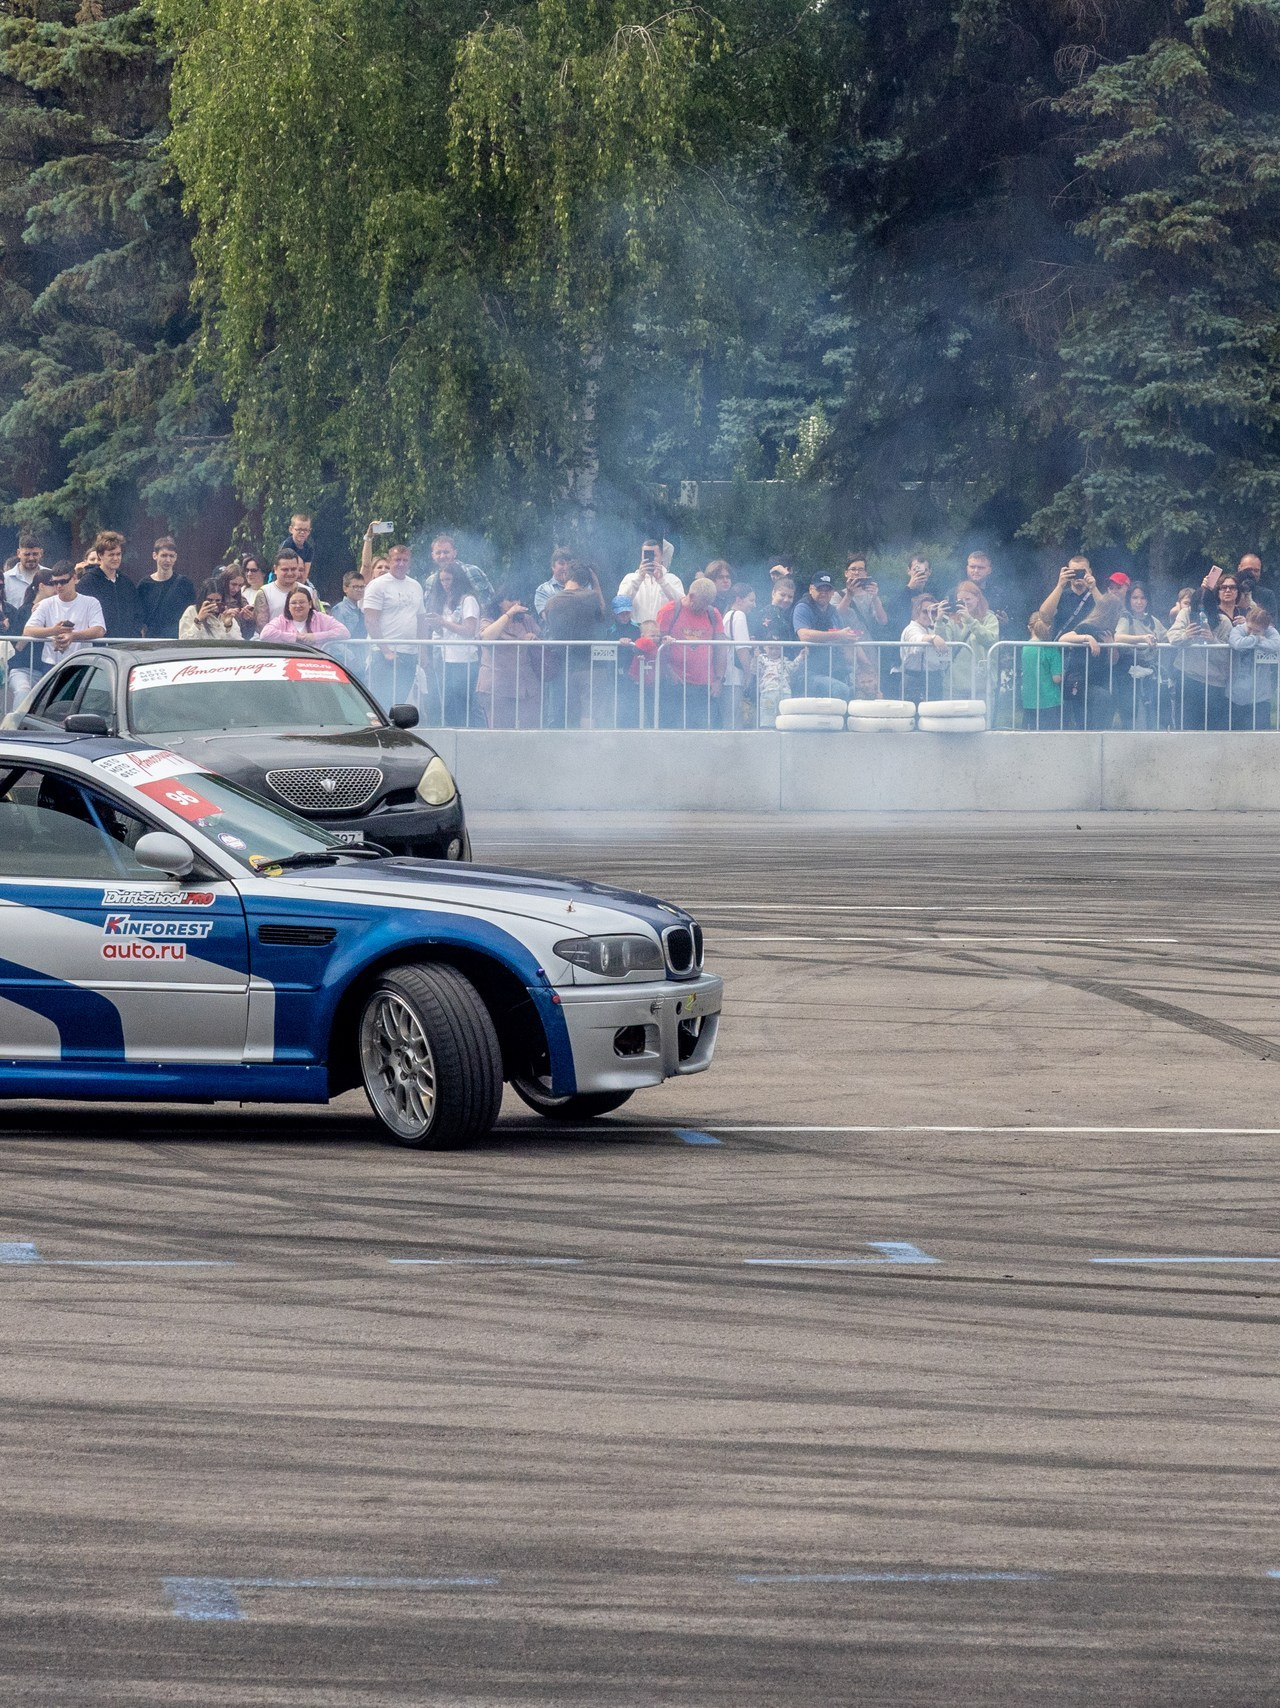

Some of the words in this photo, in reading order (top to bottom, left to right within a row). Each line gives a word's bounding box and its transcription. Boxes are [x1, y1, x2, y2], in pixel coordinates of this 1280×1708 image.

[172, 662, 277, 682] Автострада
[100, 758, 120, 769] АВТО
[110, 763, 130, 773] МОТО
[120, 767, 140, 778] ФЕСТ
[165, 790, 200, 806] 96
[104, 916, 210, 936] KINFOREST
[102, 943, 184, 959] auto.ru
